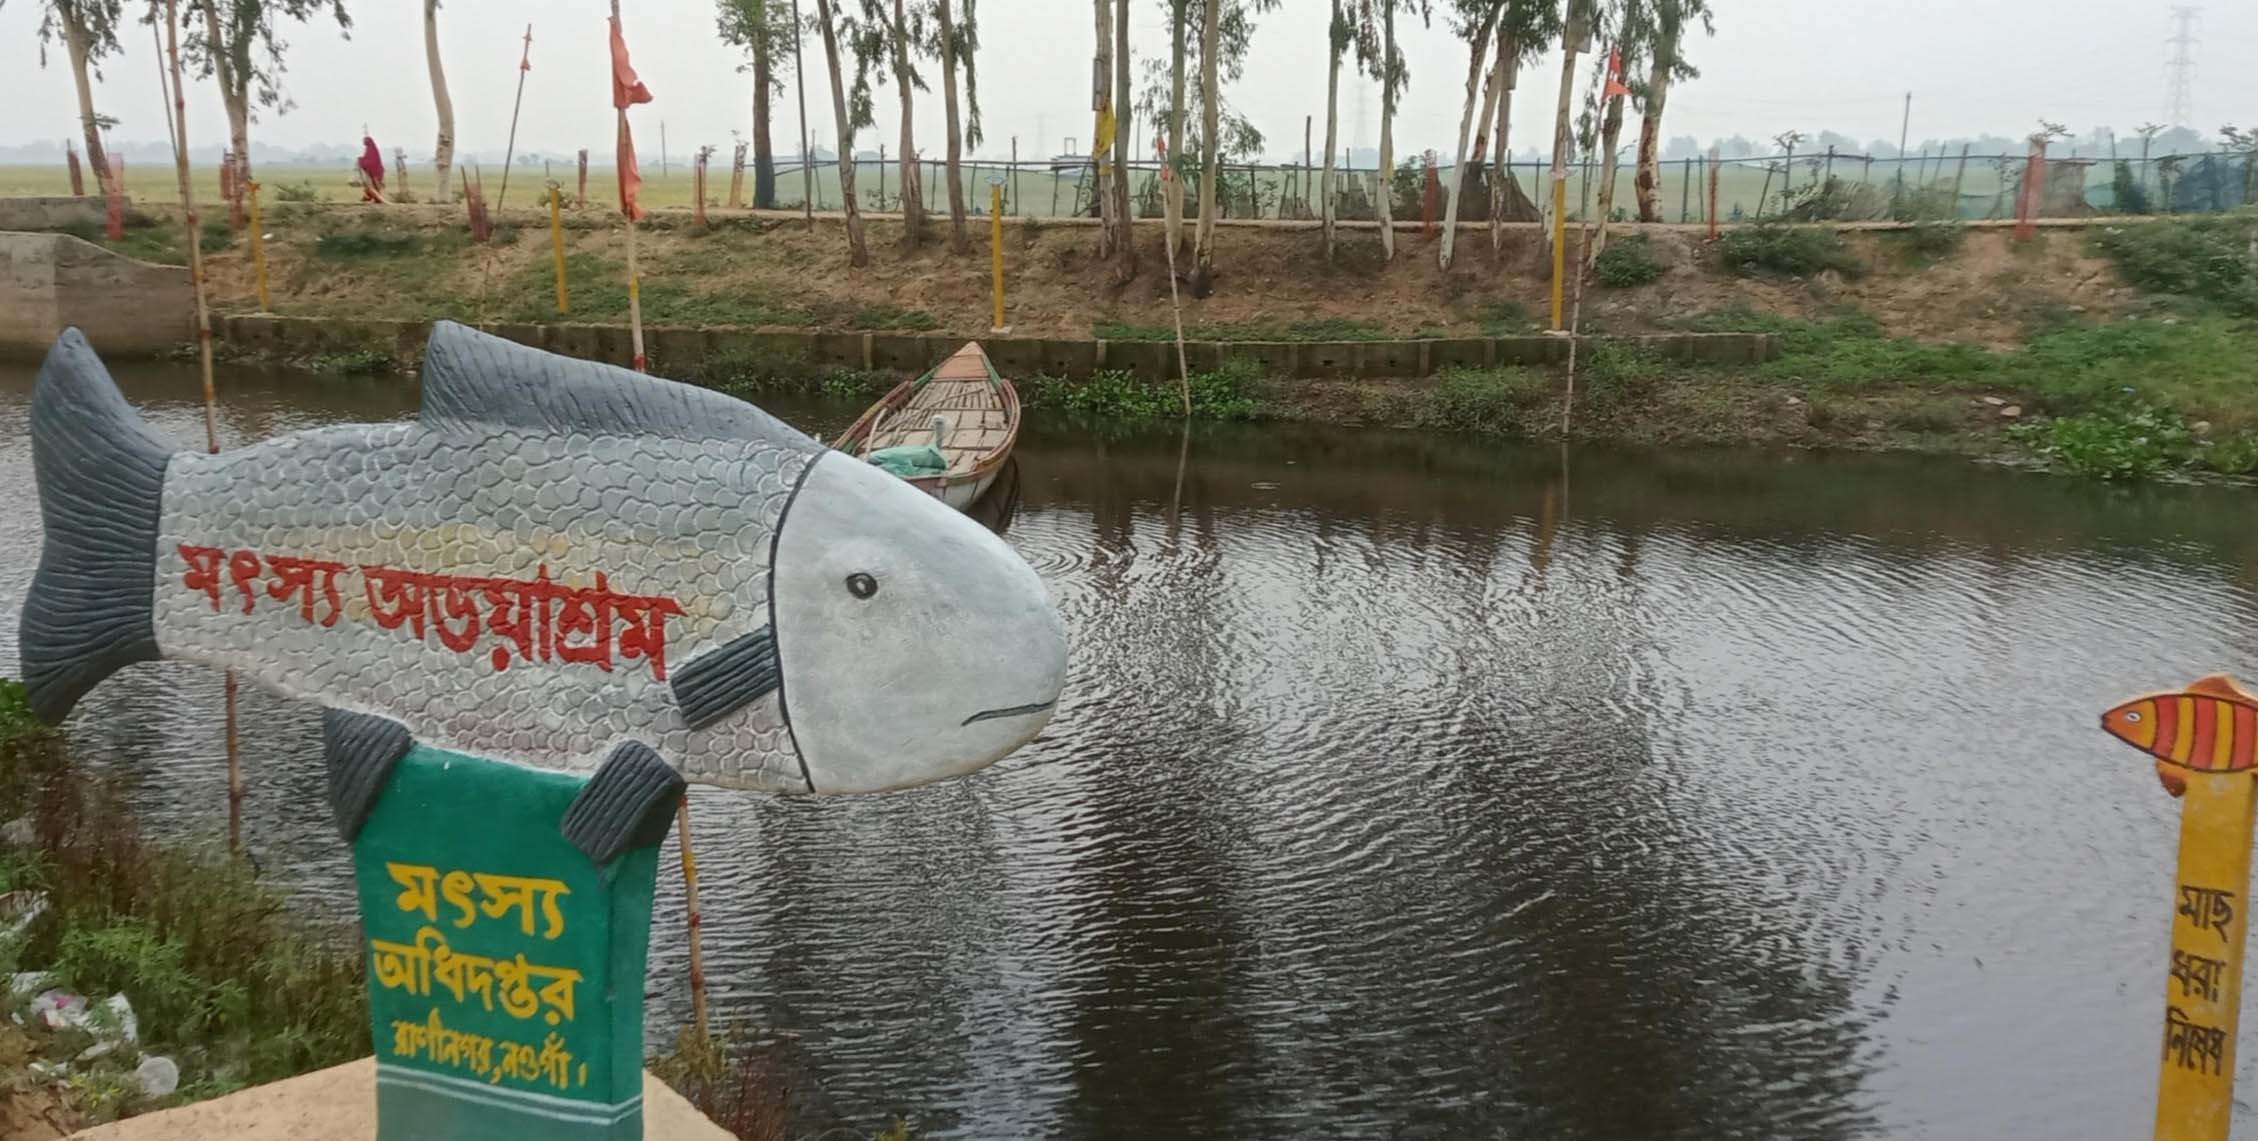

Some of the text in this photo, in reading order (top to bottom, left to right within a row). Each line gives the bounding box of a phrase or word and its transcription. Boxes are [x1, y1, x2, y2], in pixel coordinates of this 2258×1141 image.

[177, 544, 348, 628] মৎস্য
[386, 861, 571, 940] মৎস্য
[2179, 885, 2236, 943] মাছ
[371, 925, 584, 1025] অধিদপ্তর
[2171, 949, 2227, 1003] ধরা
[2163, 1005, 2227, 1076] নিষেধ
